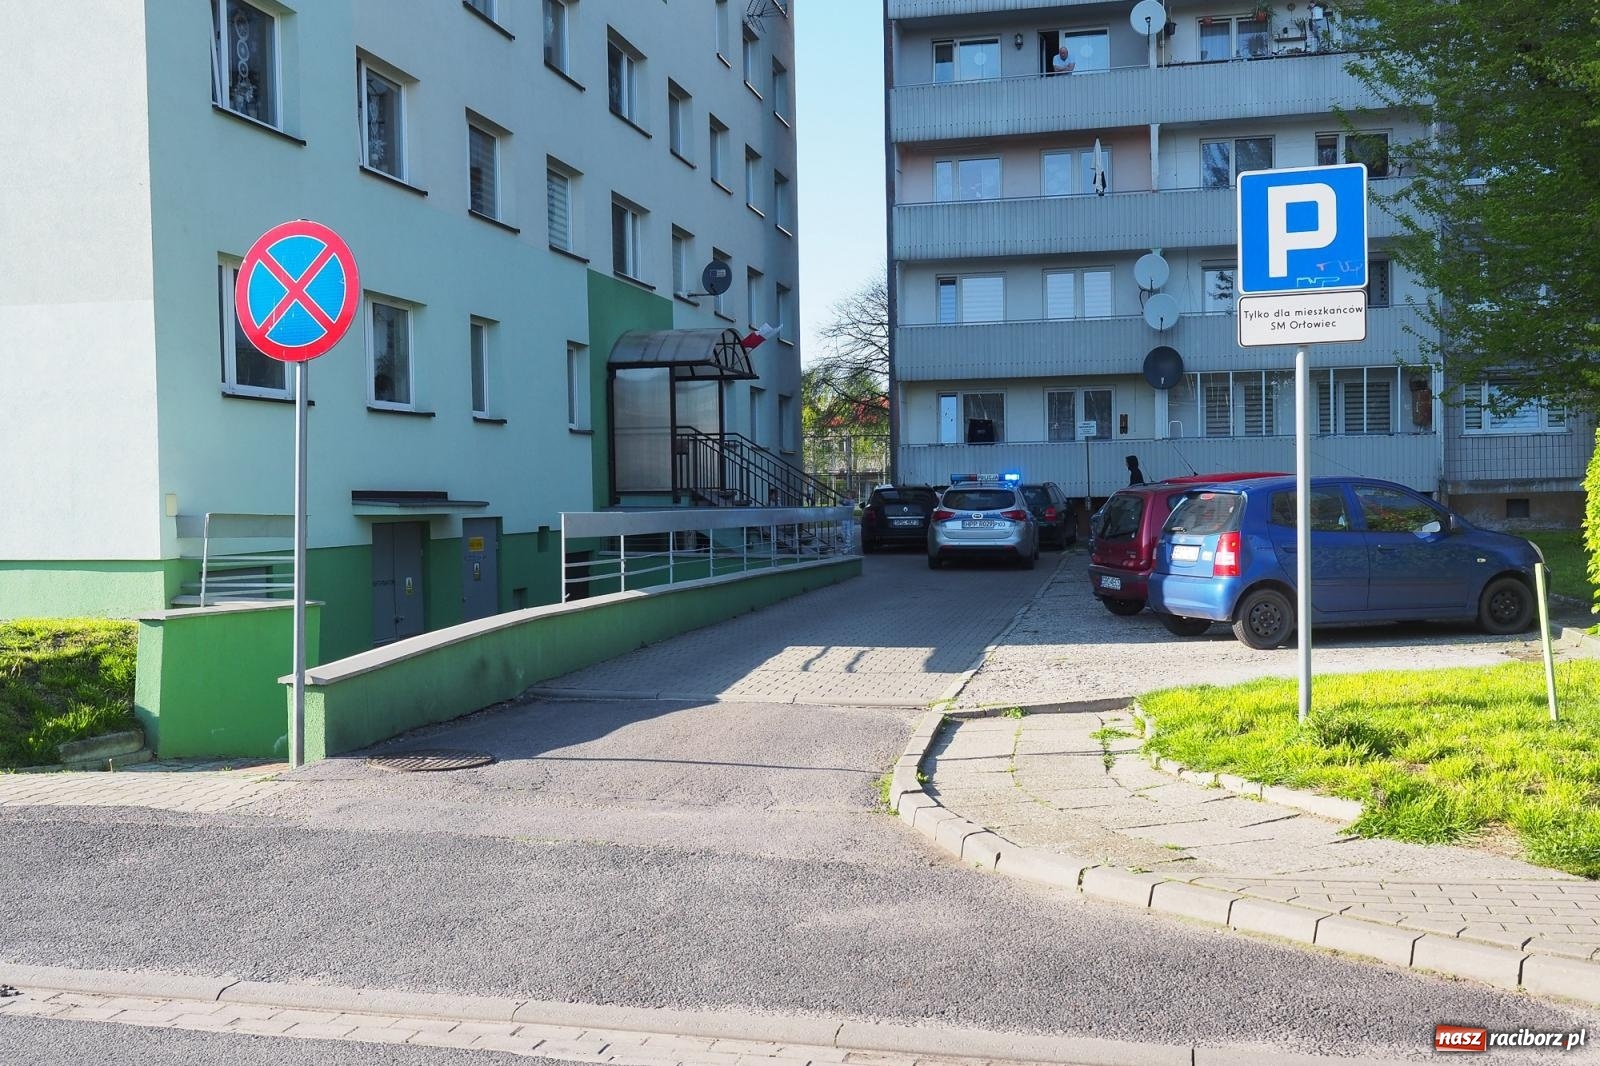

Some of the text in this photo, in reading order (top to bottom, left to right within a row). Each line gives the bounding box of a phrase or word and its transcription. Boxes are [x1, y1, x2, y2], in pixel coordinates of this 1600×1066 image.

[1268, 182, 1337, 278] P
[1243, 304, 1364, 320] Tylko dla mieszkańców
[1270, 319, 1337, 330] SM Orłowiec
